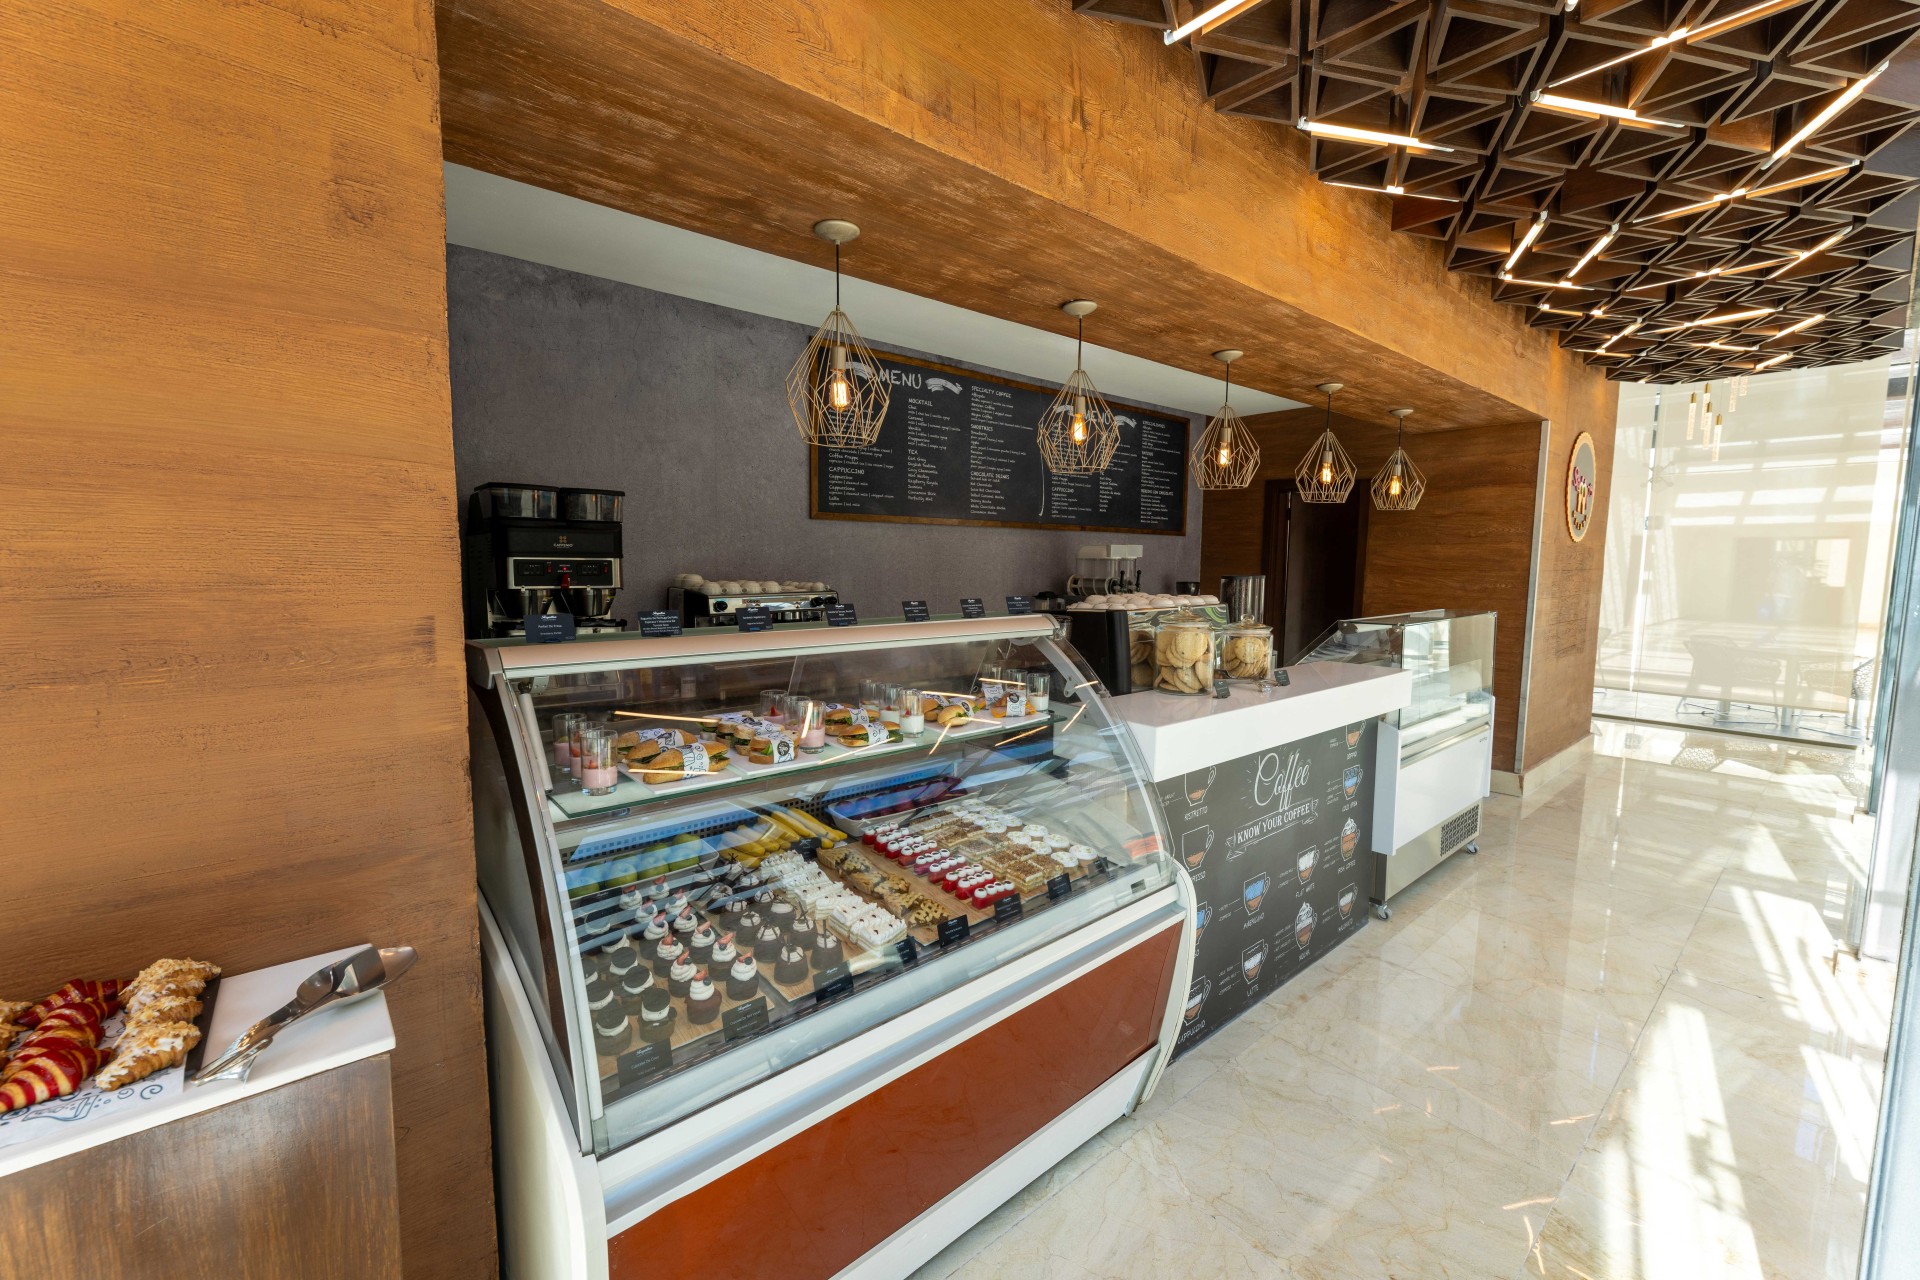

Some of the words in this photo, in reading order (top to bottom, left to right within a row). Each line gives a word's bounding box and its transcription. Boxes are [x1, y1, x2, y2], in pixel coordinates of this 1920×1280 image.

[879, 368, 922, 389] MENU
[971, 385, 995, 395] SPECIALTY
[995, 390, 1012, 399] COFFEE
[908, 397, 933, 407] MOCKTAIL
[828, 466, 865, 475] CAPPUCCINO
[1254, 752, 1310, 813] Coffee
[1184, 805, 1208, 821] RISTRETTO
[1237, 821, 1261, 844] KNOW
[1262, 814, 1283, 833] YOUR
[1283, 802, 1311, 823] COFFEE
[1243, 912, 1265, 930] AMERICANO
[1246, 983, 1259, 998] LATTE
[1177, 1020, 1206, 1044] CAPPUCCINO
